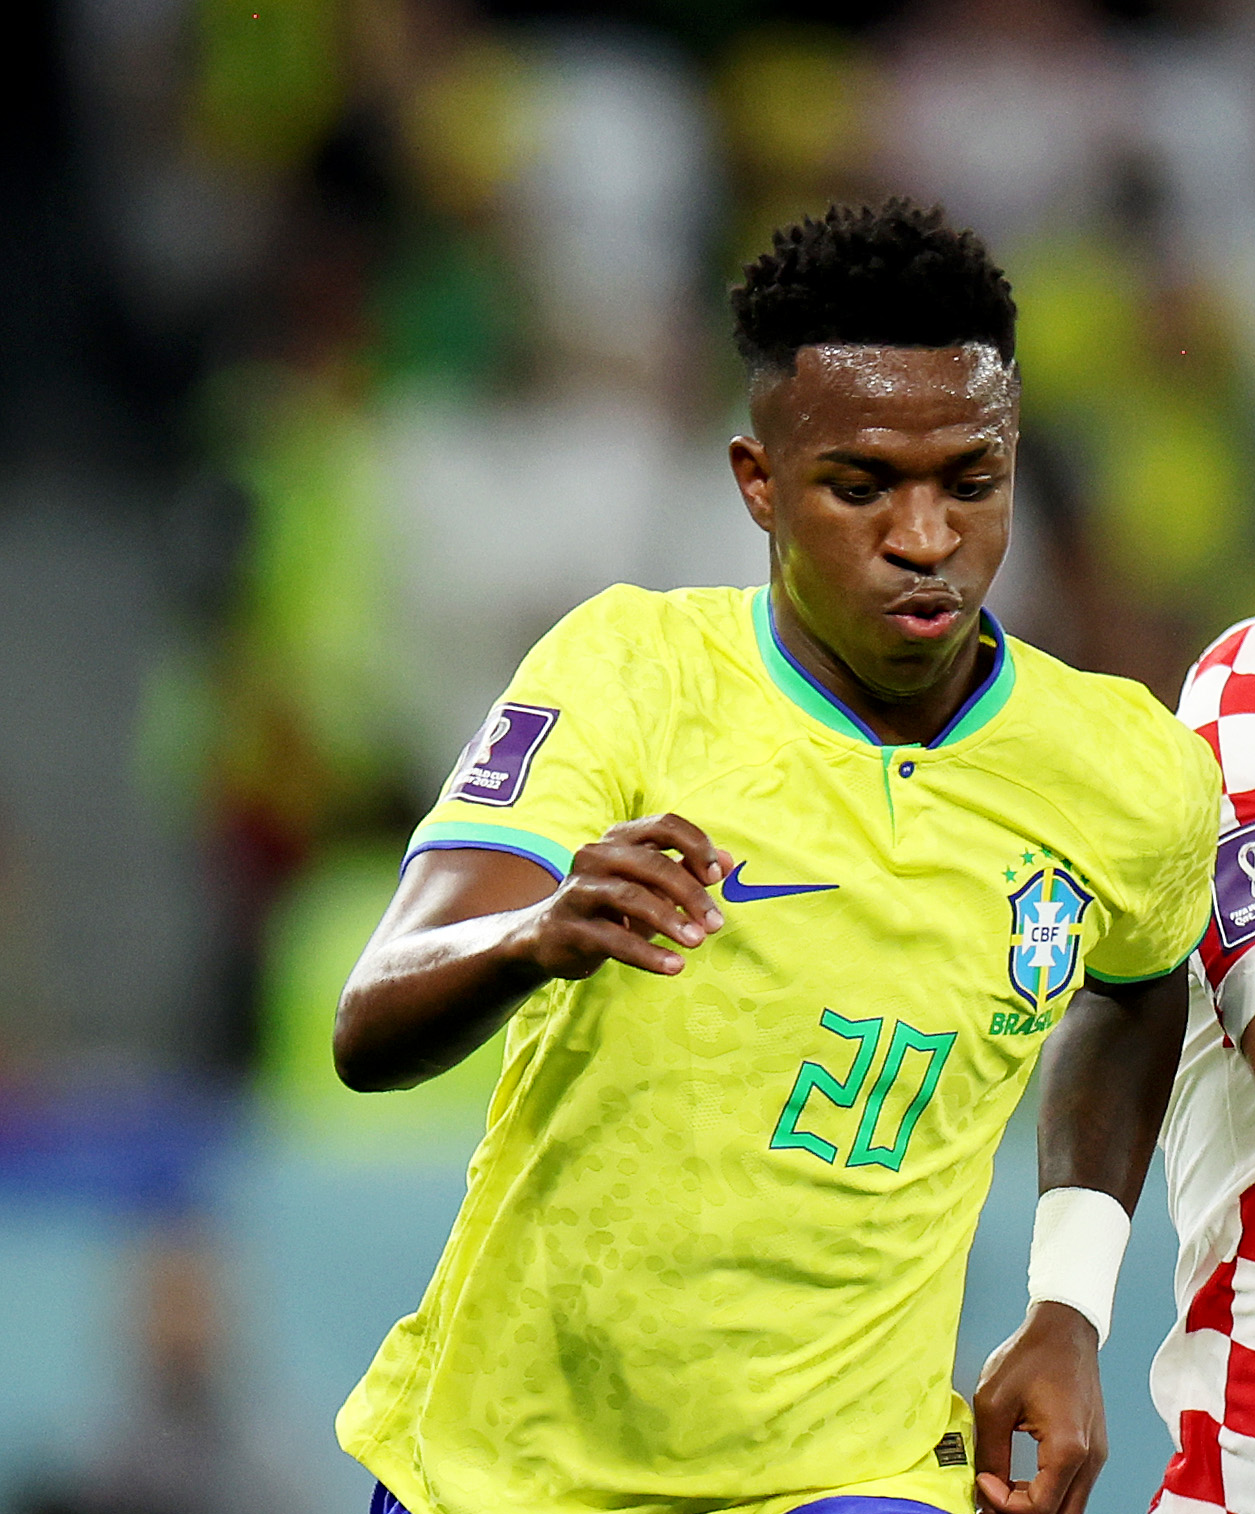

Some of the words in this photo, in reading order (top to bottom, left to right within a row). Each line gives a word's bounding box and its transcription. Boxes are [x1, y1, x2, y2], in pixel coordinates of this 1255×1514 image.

[1031, 926, 1059, 942] CBF
[989, 1007, 1054, 1036] BRASIL
[769, 1008, 958, 1172] 20
